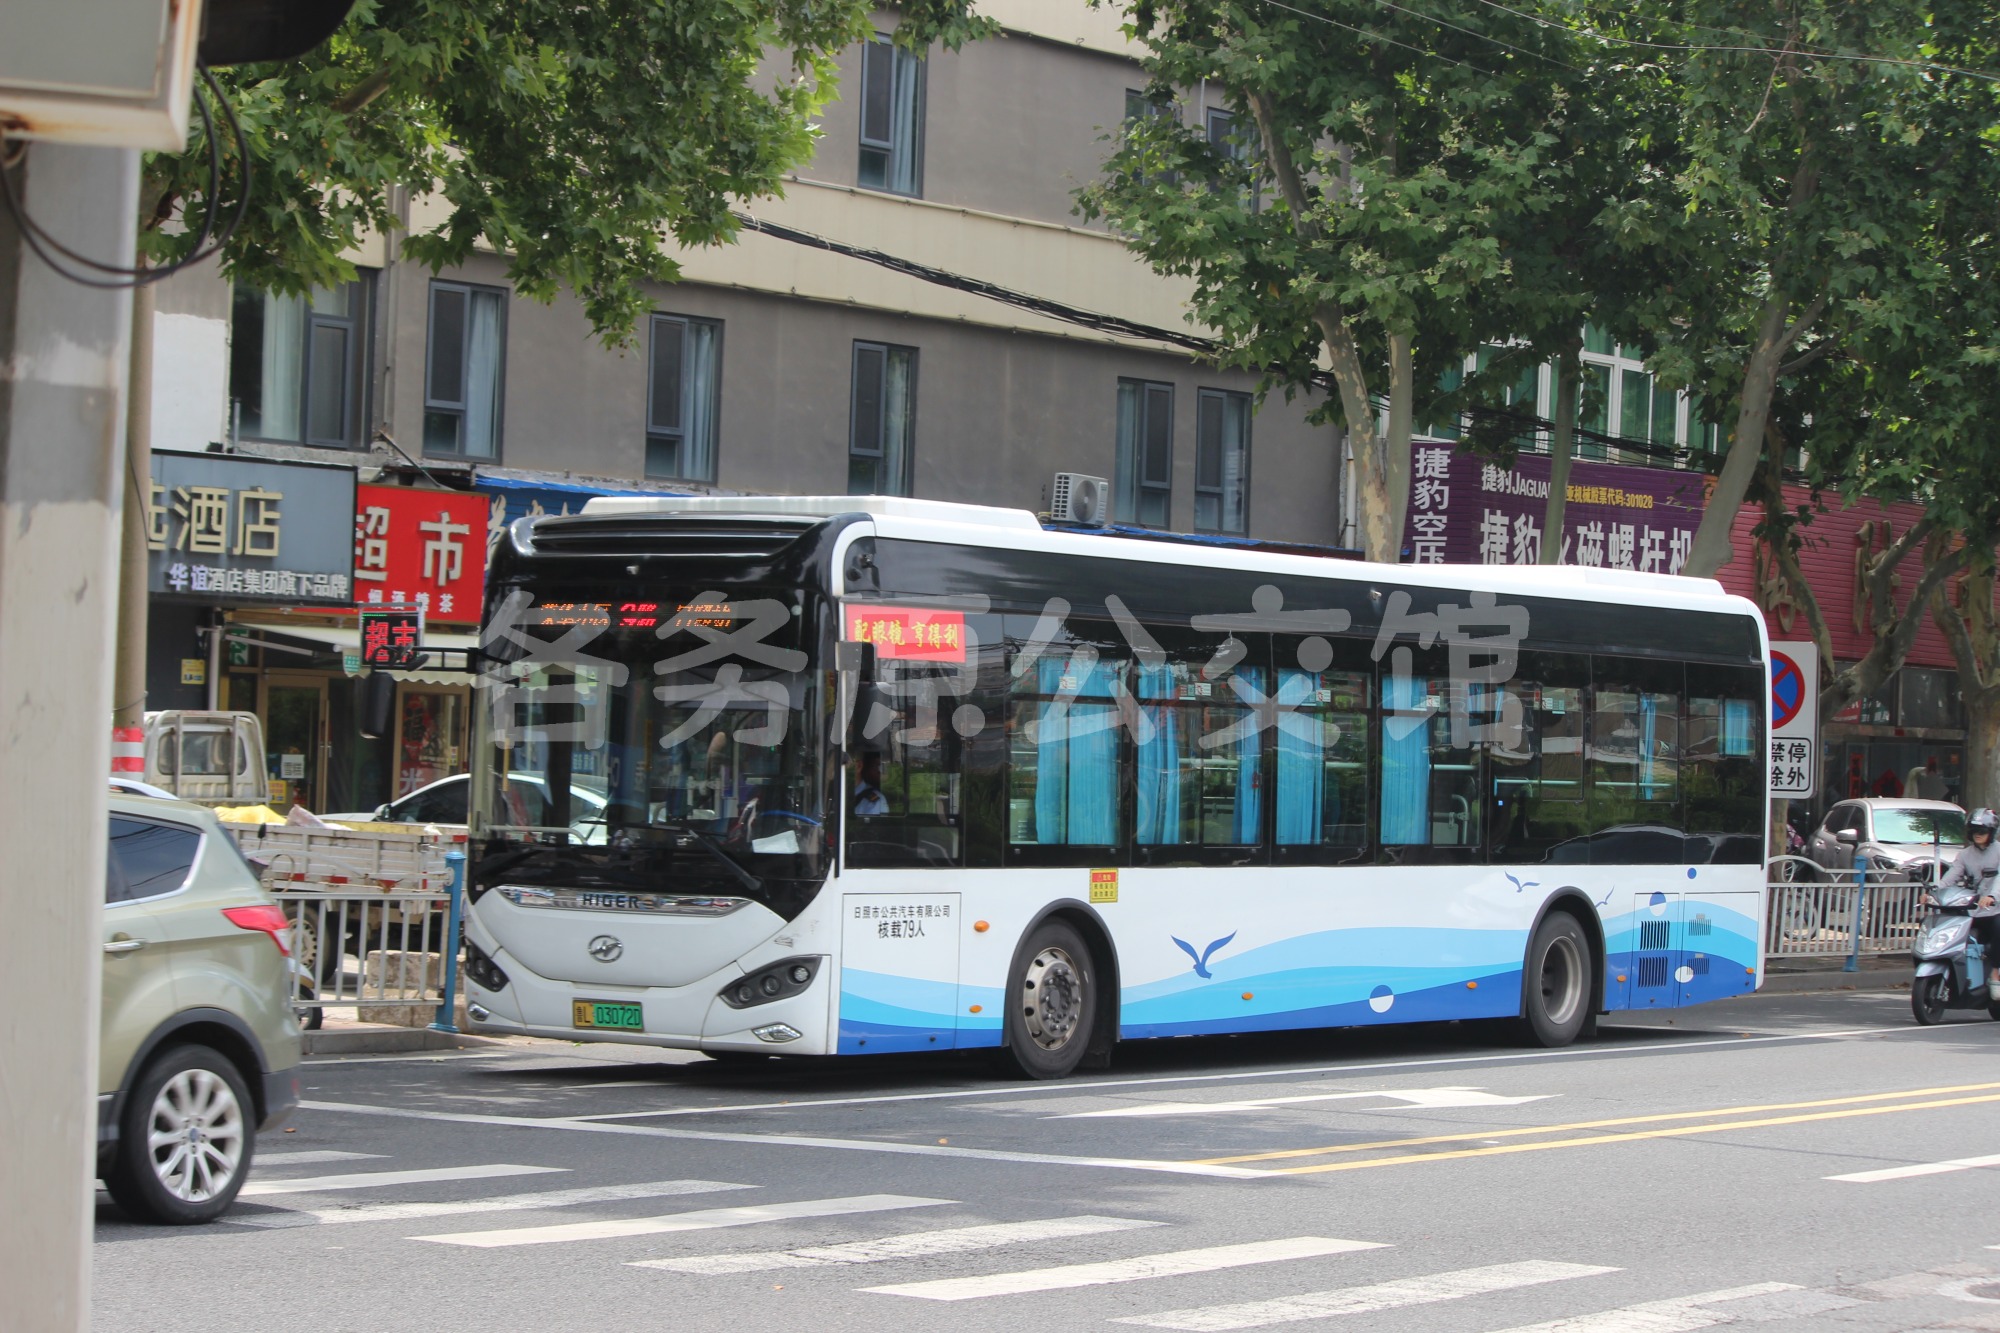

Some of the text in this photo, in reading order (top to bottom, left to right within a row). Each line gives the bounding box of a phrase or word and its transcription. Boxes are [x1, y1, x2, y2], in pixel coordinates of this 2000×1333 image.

[169, 563, 348, 599] 华谊酒店集团旗下品牌
[583, 893, 640, 908] HIGER
[854, 904, 950, 919] 日照市公共汽车有限公司
[878, 920, 925, 939] 核载79人
